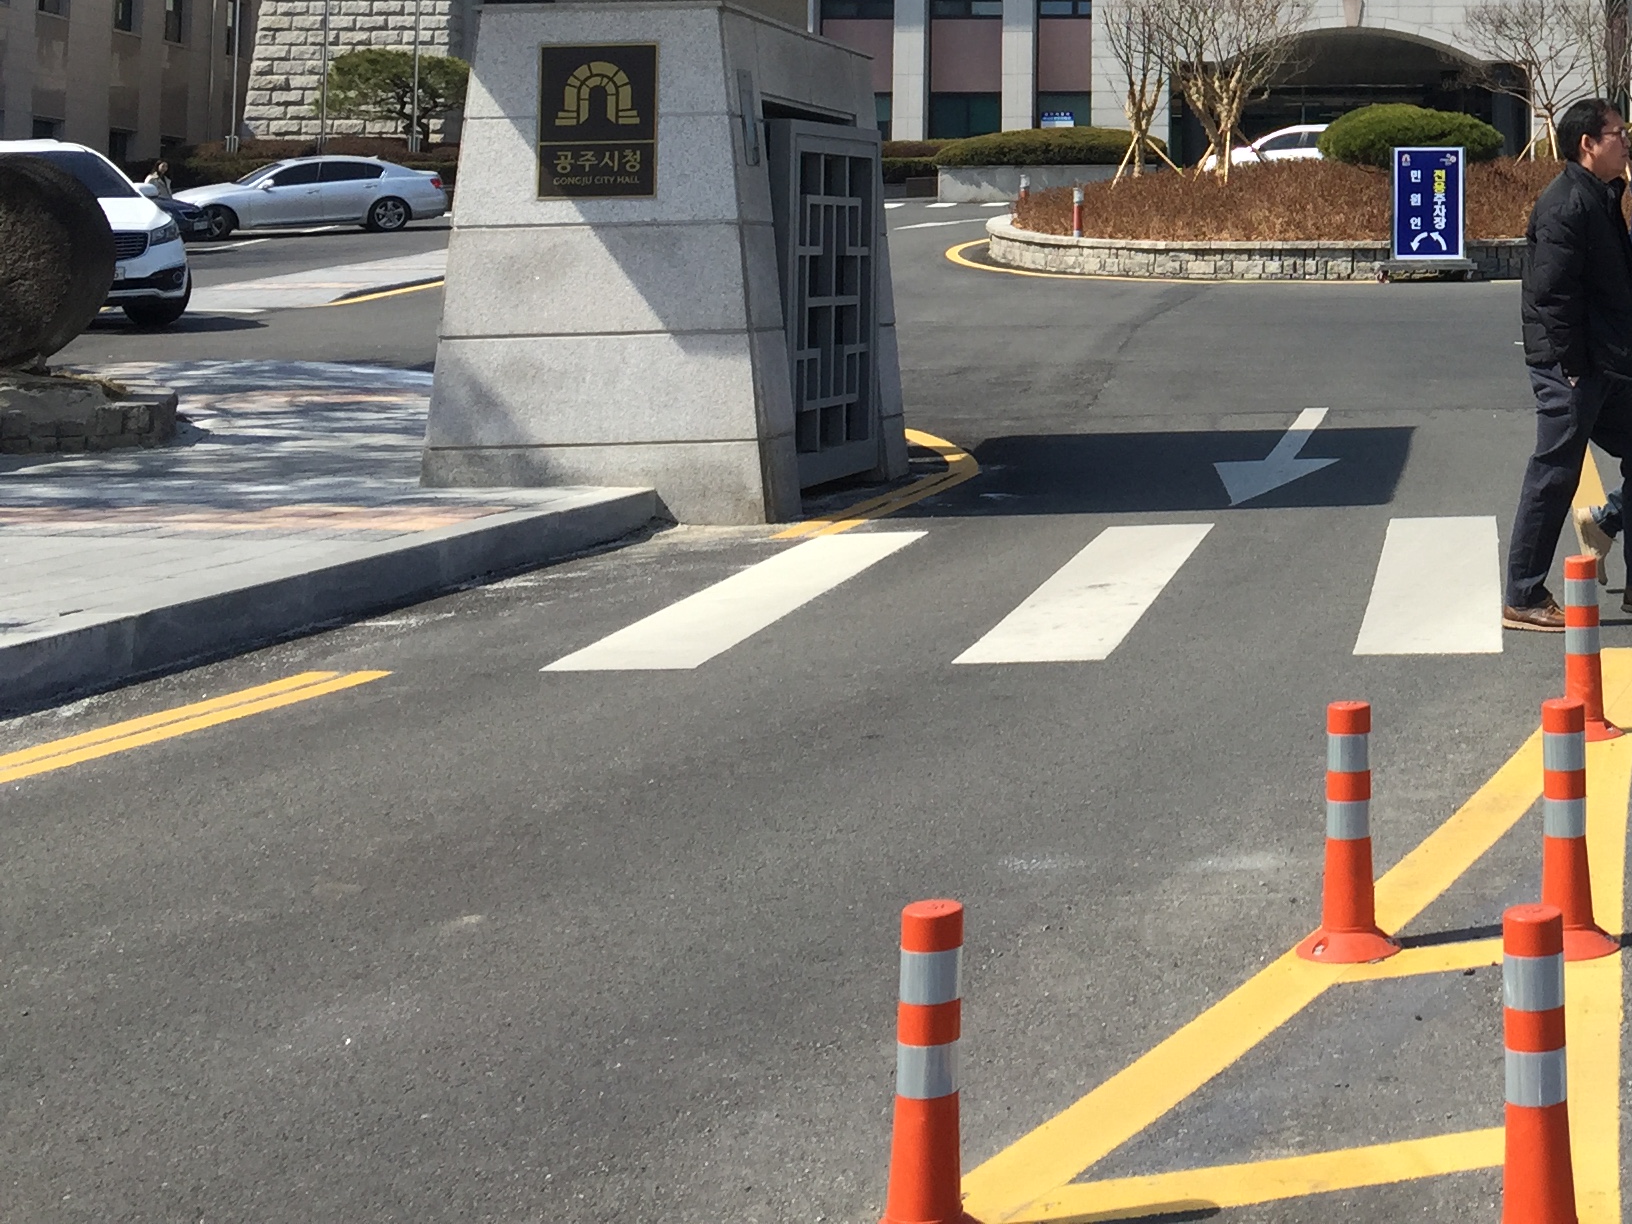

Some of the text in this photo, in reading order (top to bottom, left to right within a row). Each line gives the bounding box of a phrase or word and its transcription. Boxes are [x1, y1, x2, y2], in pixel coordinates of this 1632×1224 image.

[553, 149, 641, 174] 공주시청
[553, 176, 640, 186] GONGJU CITY HALL
[1410, 169, 1422, 230] 민원인
[1433, 169, 1446, 230] 전용주차장
